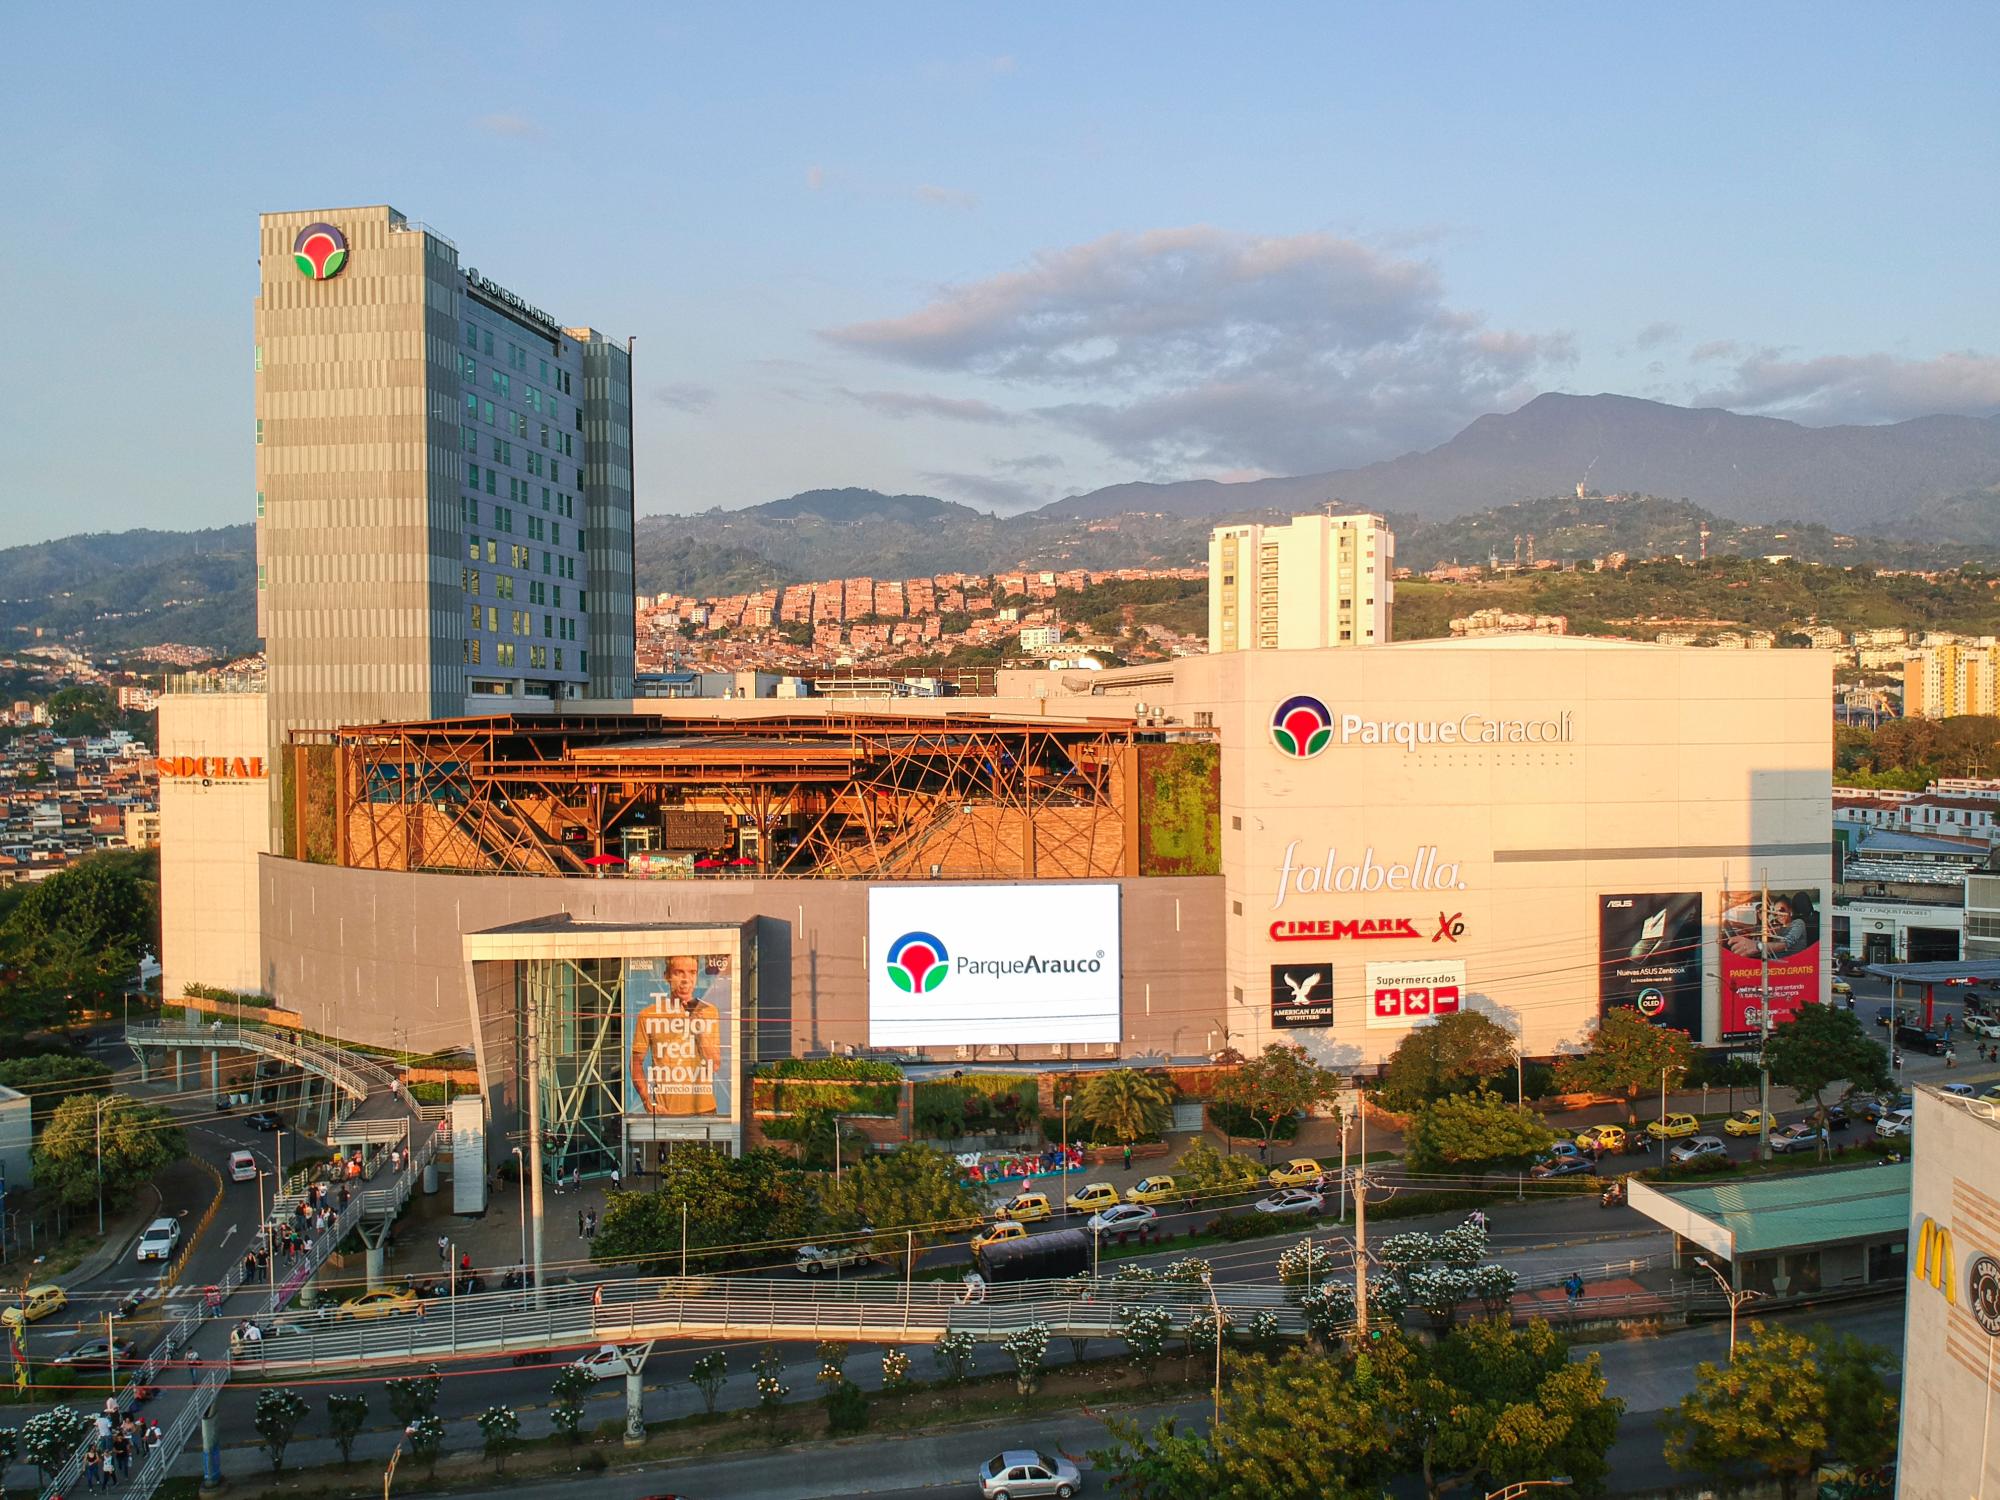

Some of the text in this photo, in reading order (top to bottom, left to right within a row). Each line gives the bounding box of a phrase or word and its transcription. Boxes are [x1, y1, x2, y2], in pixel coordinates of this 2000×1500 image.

[482, 277, 560, 330] SONESTA HOTEL
[1340, 710, 1574, 752] ParqueCaracolí
[156, 756, 269, 778] SOCIAL
[1606, 899, 1633, 908] ASUS
[1269, 918, 1423, 942] CINEMARK
[708, 957, 729, 972] tigo
[1640, 967, 1658, 975] ASUS
[1658, 966, 1686, 975] Zenbook
[1787, 965, 1814, 975] GRATIS
[1376, 974, 1456, 986] Supermercados
[649, 992, 681, 1015] Tu
[1310, 1007, 1332, 1015] EAGLE
[645, 1011, 718, 1039] mejor
[656, 1035, 696, 1059] red
[647, 1058, 714, 1083] móvil
[665, 1084, 690, 1095] precio
[691, 1084, 712, 1095] justo
